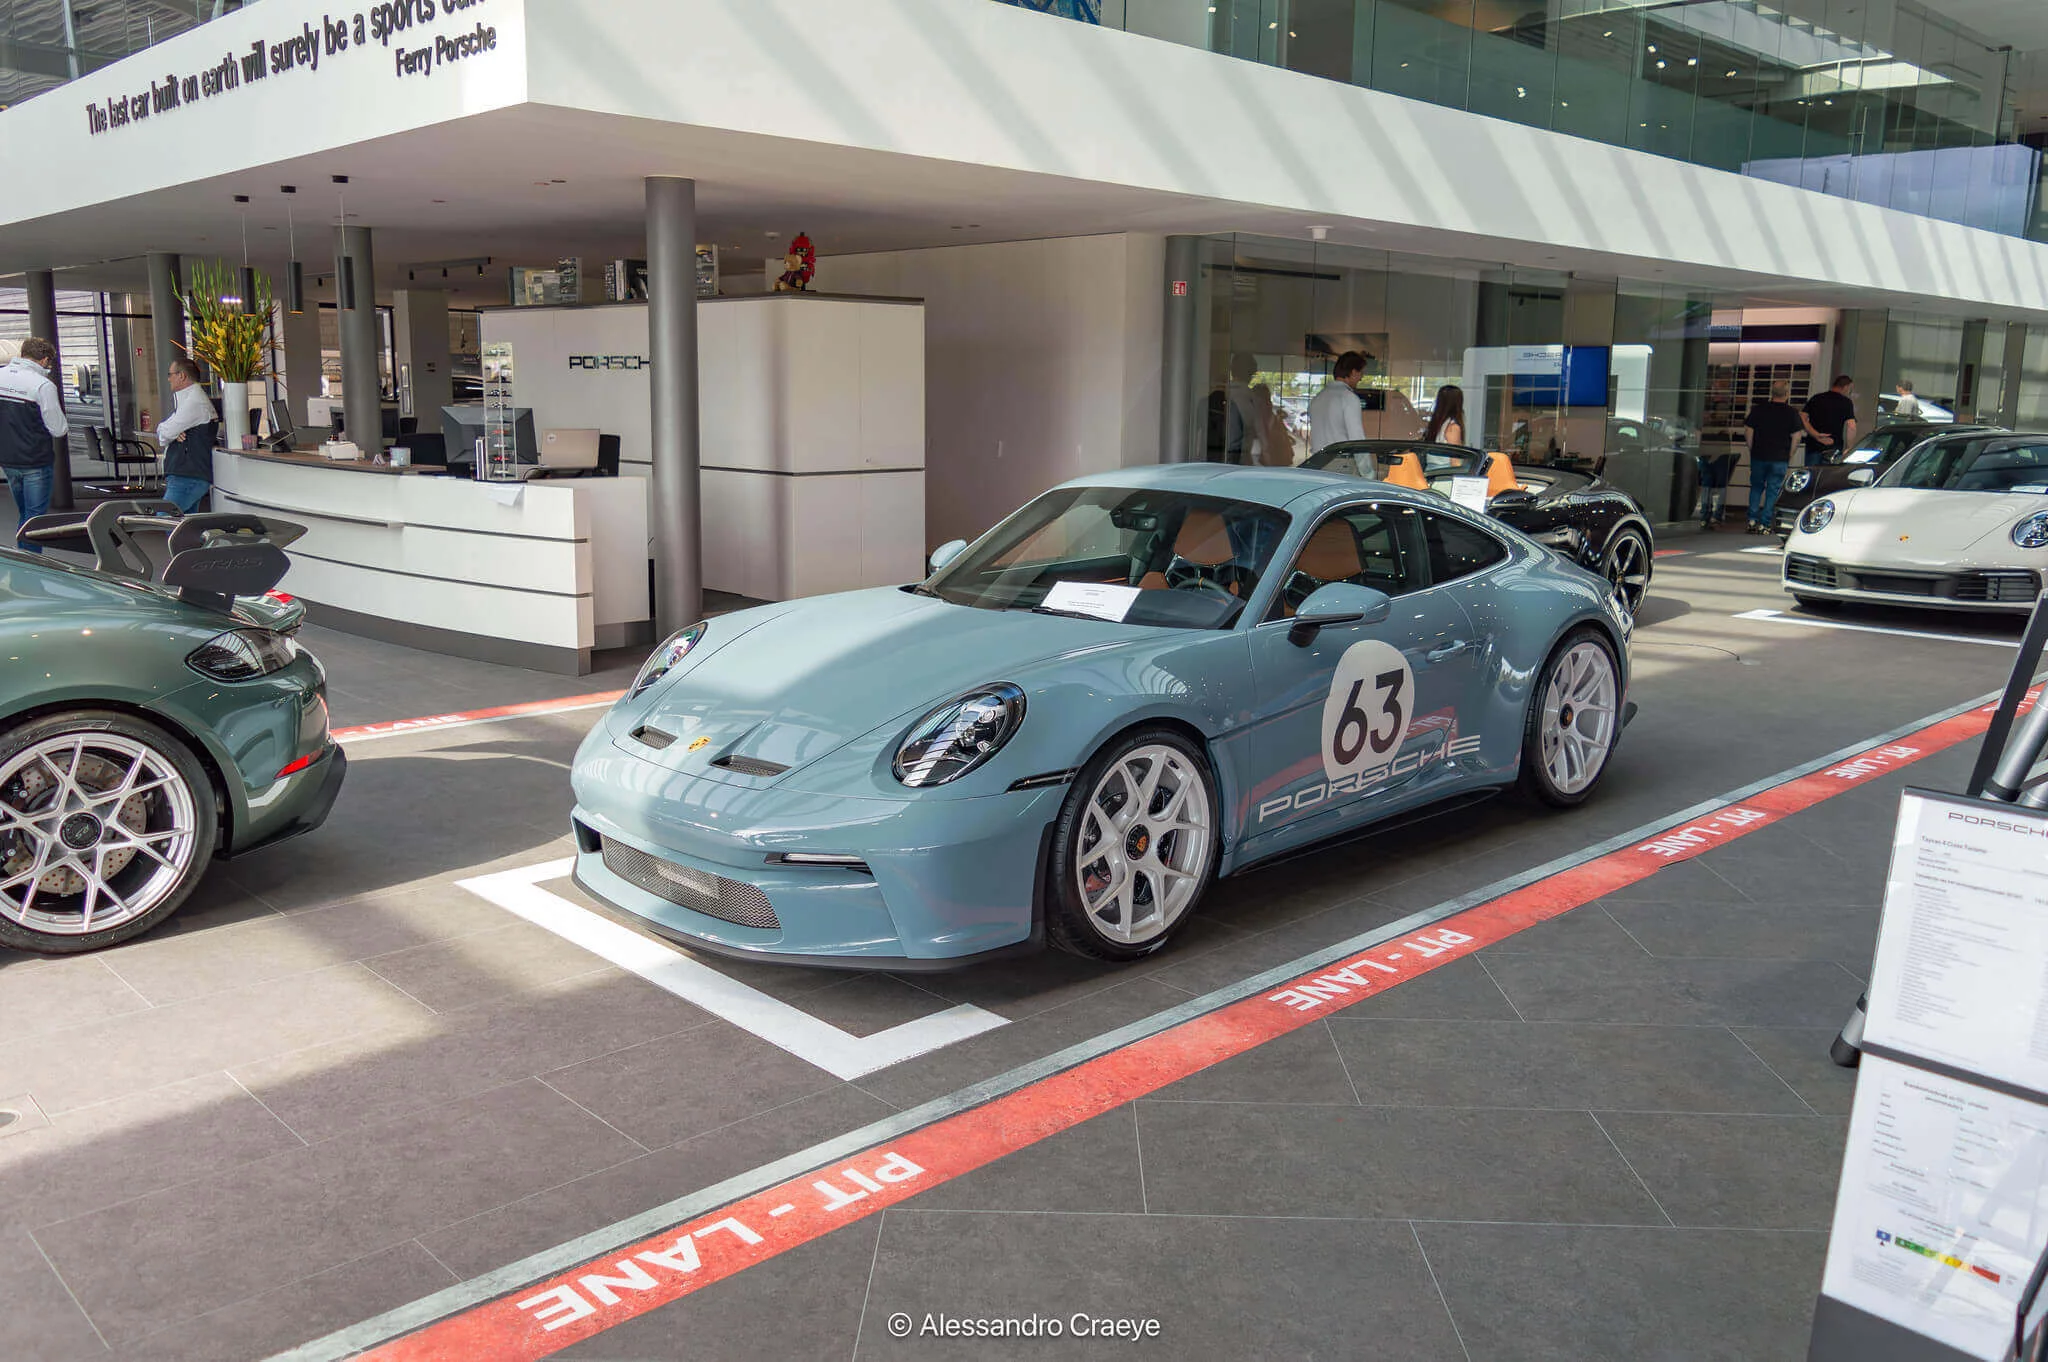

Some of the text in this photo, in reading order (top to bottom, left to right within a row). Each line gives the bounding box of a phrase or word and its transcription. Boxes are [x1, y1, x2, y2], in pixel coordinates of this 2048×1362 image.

[86, 0, 435, 135] The last car built on earth will surely be a sports
[395, 22, 496, 77] Ferry Porsche
[569, 355, 650, 369] PORSCH
[1333, 668, 1404, 766] 63
[1824, 758, 1889, 779] LANE
[1878, 745, 1921, 759] PIT
[1258, 734, 1481, 824] PORSCHE
[1715, 808, 1767, 826] PIT
[1948, 812, 2048, 838] PORSCH
[1638, 826, 1723, 857] LANE
[1403, 928, 1475, 958] PIT
[1268, 959, 1398, 1011] LANE
[812, 1151, 927, 1212] PIT
[516, 1216, 764, 1332] LANE
